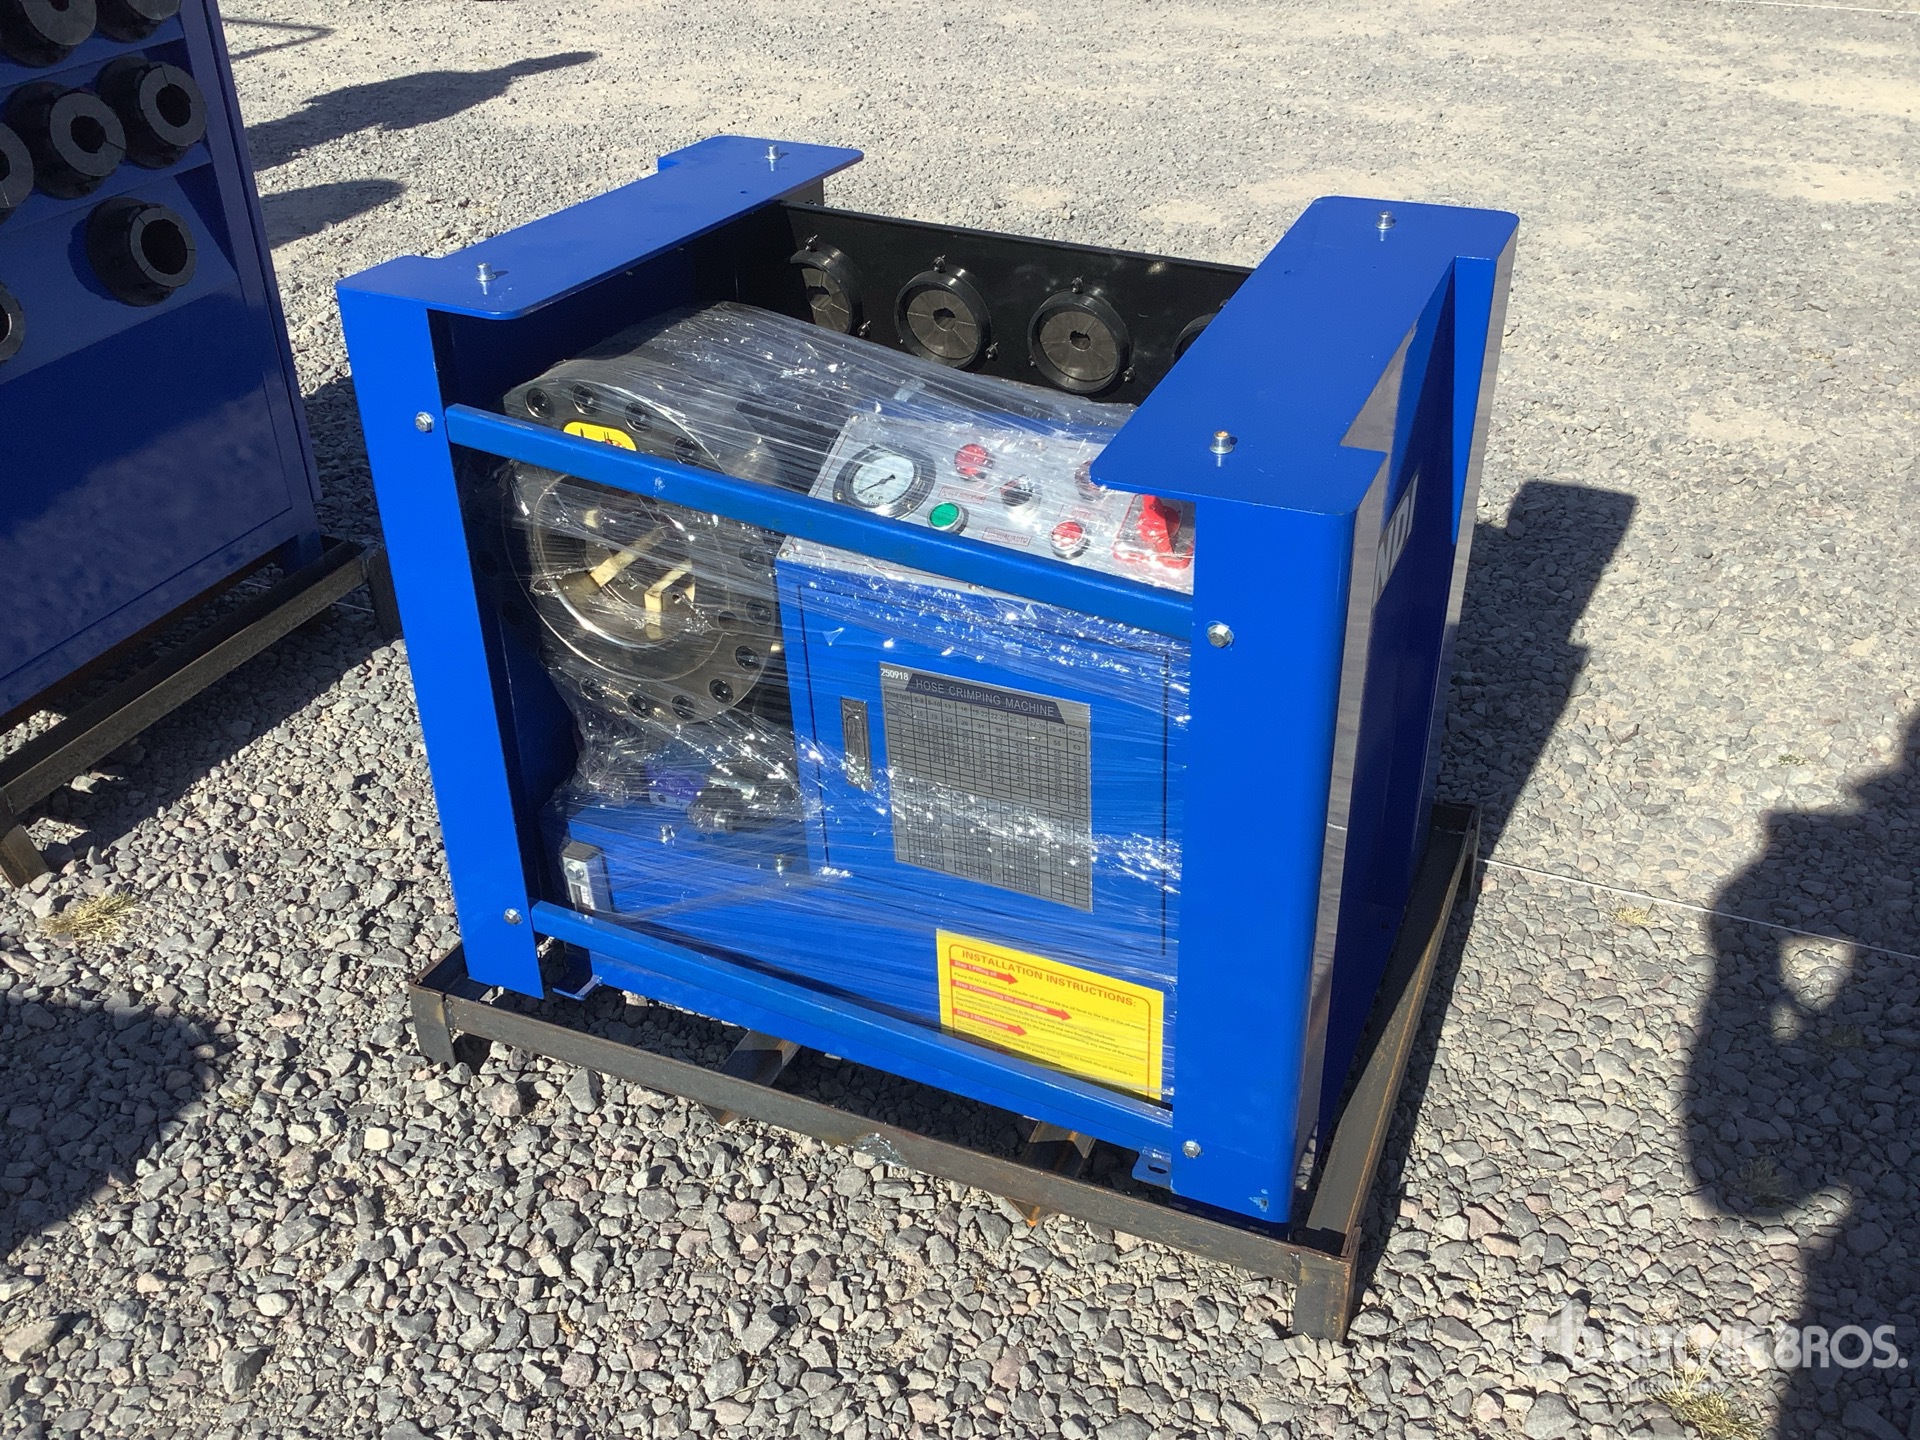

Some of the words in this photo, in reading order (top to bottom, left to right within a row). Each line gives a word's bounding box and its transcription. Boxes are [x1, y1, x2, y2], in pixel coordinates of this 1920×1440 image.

[880, 667, 909, 682] 250918
[916, 679, 944, 694] HOSE
[949, 686, 1001, 706] CRIMPING
[1005, 698, 1054, 717] MACHINE
[955, 961, 967, 969] Step
[962, 950, 1042, 980] INSTALLATION
[1046, 974, 1136, 1008] INSTRUCTIONS:
[956, 981, 968, 989] Step
[1015, 999, 1032, 1009] power
[957, 1010, 969, 1018] Step
